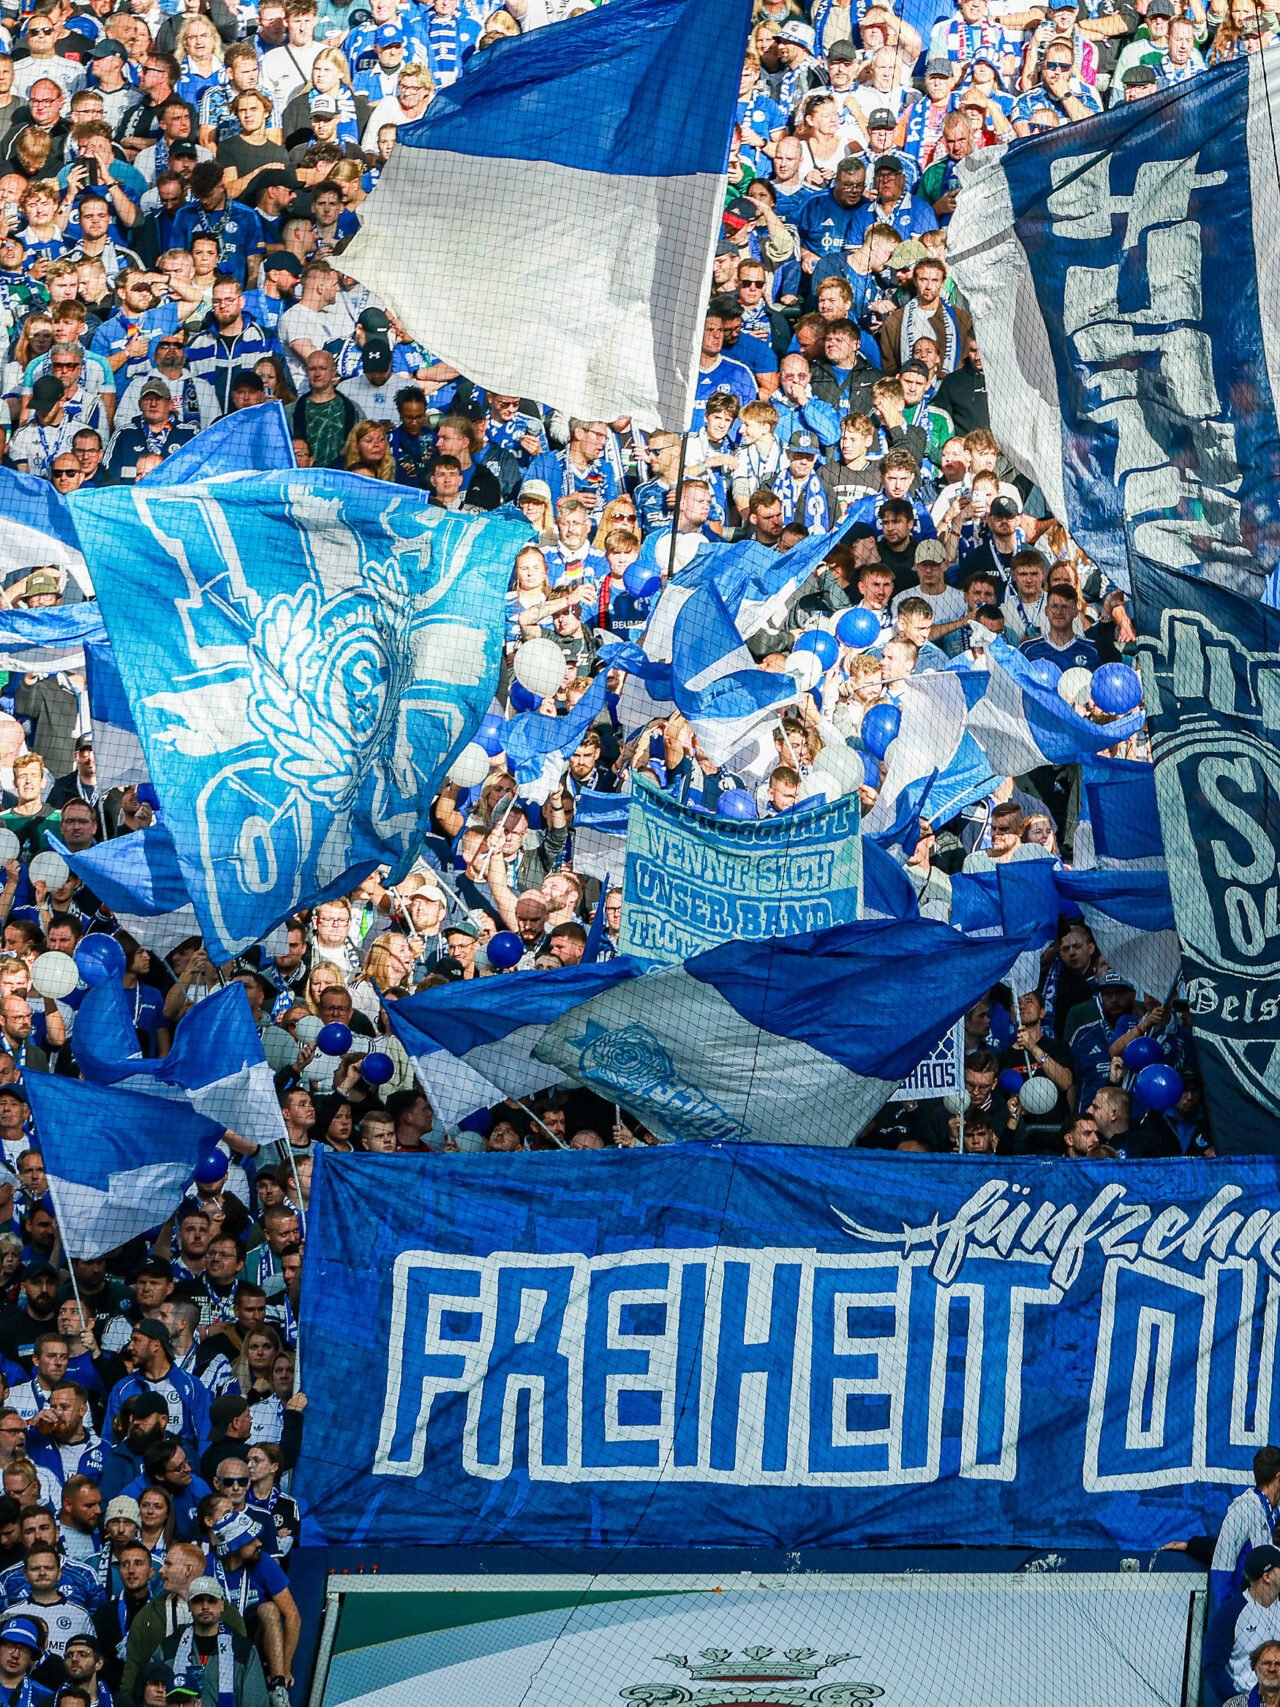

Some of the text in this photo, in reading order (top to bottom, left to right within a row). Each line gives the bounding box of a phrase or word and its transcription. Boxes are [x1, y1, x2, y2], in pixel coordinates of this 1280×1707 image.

[636, 859, 733, 933] UNSER
[757, 851, 834, 894] SICH
[372, 1245, 1063, 1486] FREIHEIT
